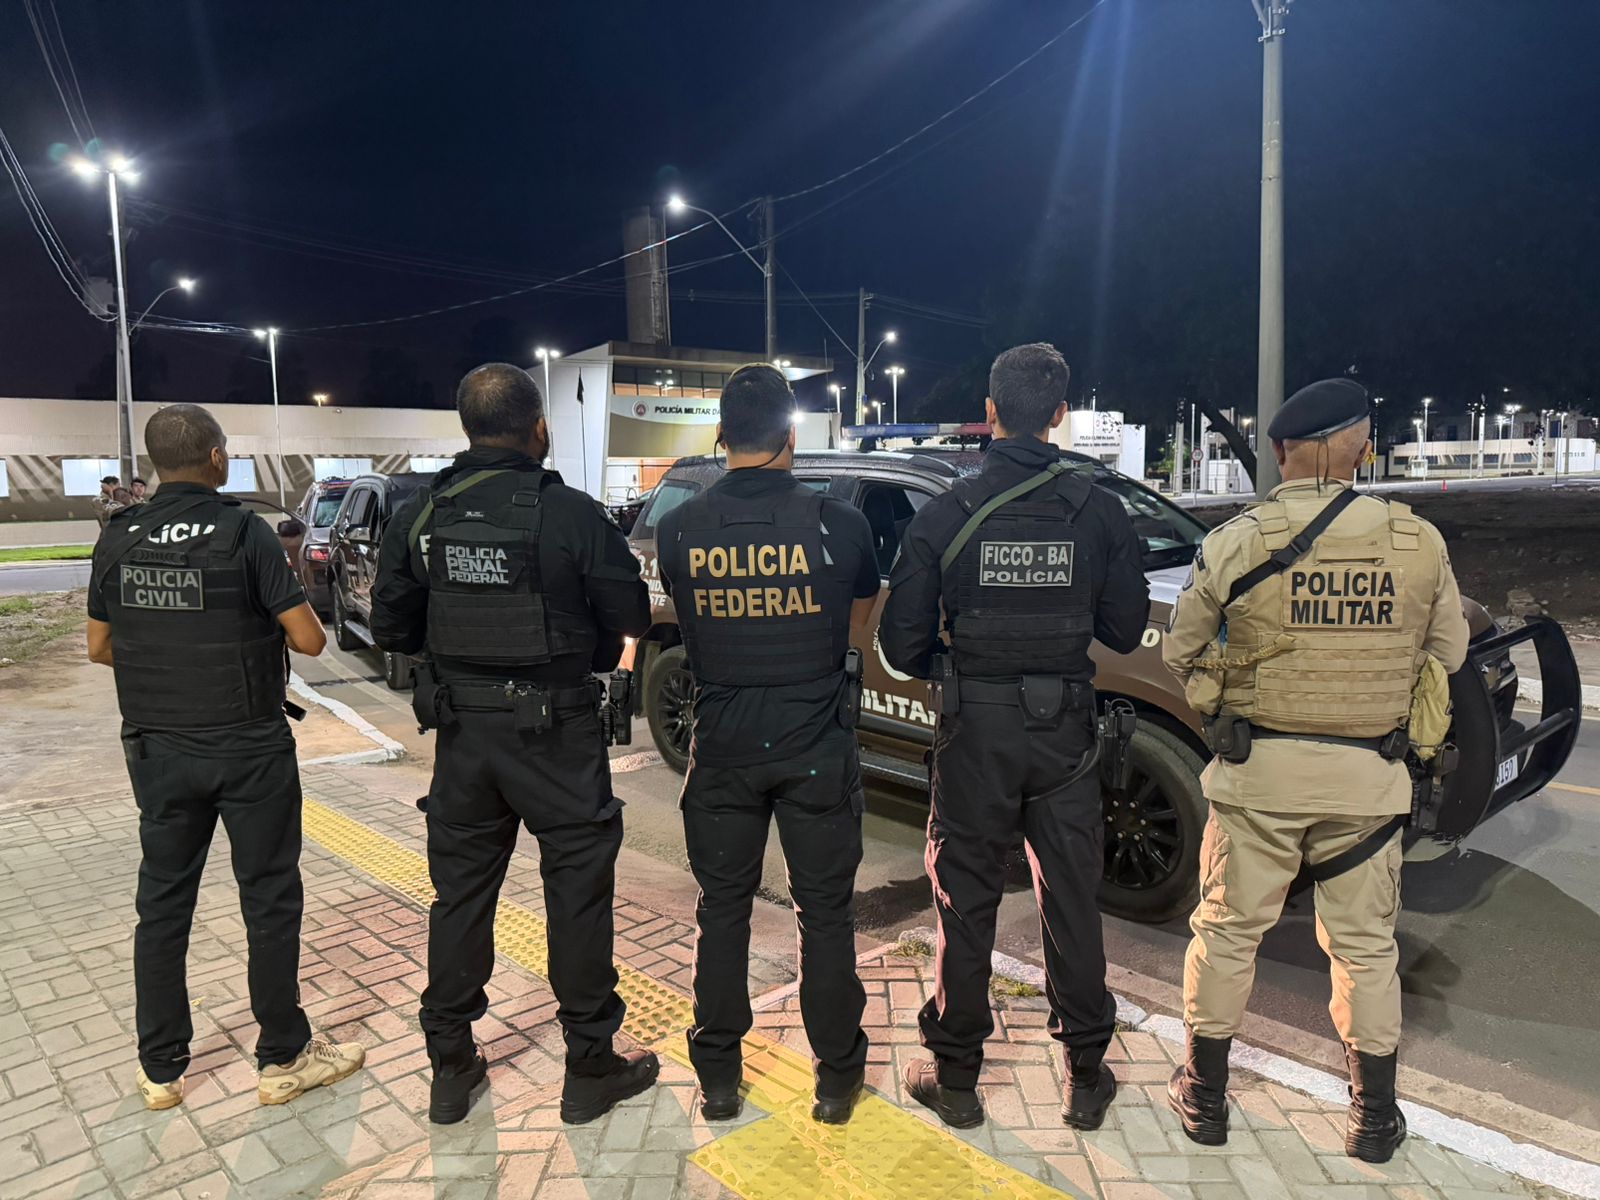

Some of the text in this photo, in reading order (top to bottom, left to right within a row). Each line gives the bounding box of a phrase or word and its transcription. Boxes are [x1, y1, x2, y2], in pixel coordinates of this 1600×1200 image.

[655, 405, 682, 414] POLÍCIA
[684, 407, 711, 415] MILITAR
[446, 556, 509, 574] PENAL
[689, 544, 810, 578] POLÍCIA
[984, 546, 1033, 566] FICCO
[1047, 546, 1069, 565] BA
[448, 570, 509, 584] FEDERAL
[983, 569, 1068, 583] POLÍCIA
[1291, 568, 1396, 597] POLÍCIA
[135, 588, 189, 607] CIVIL
[693, 585, 822, 618] FEDERAL
[1290, 600, 1393, 625] MILITAR
[861, 687, 937, 727] ILITA
